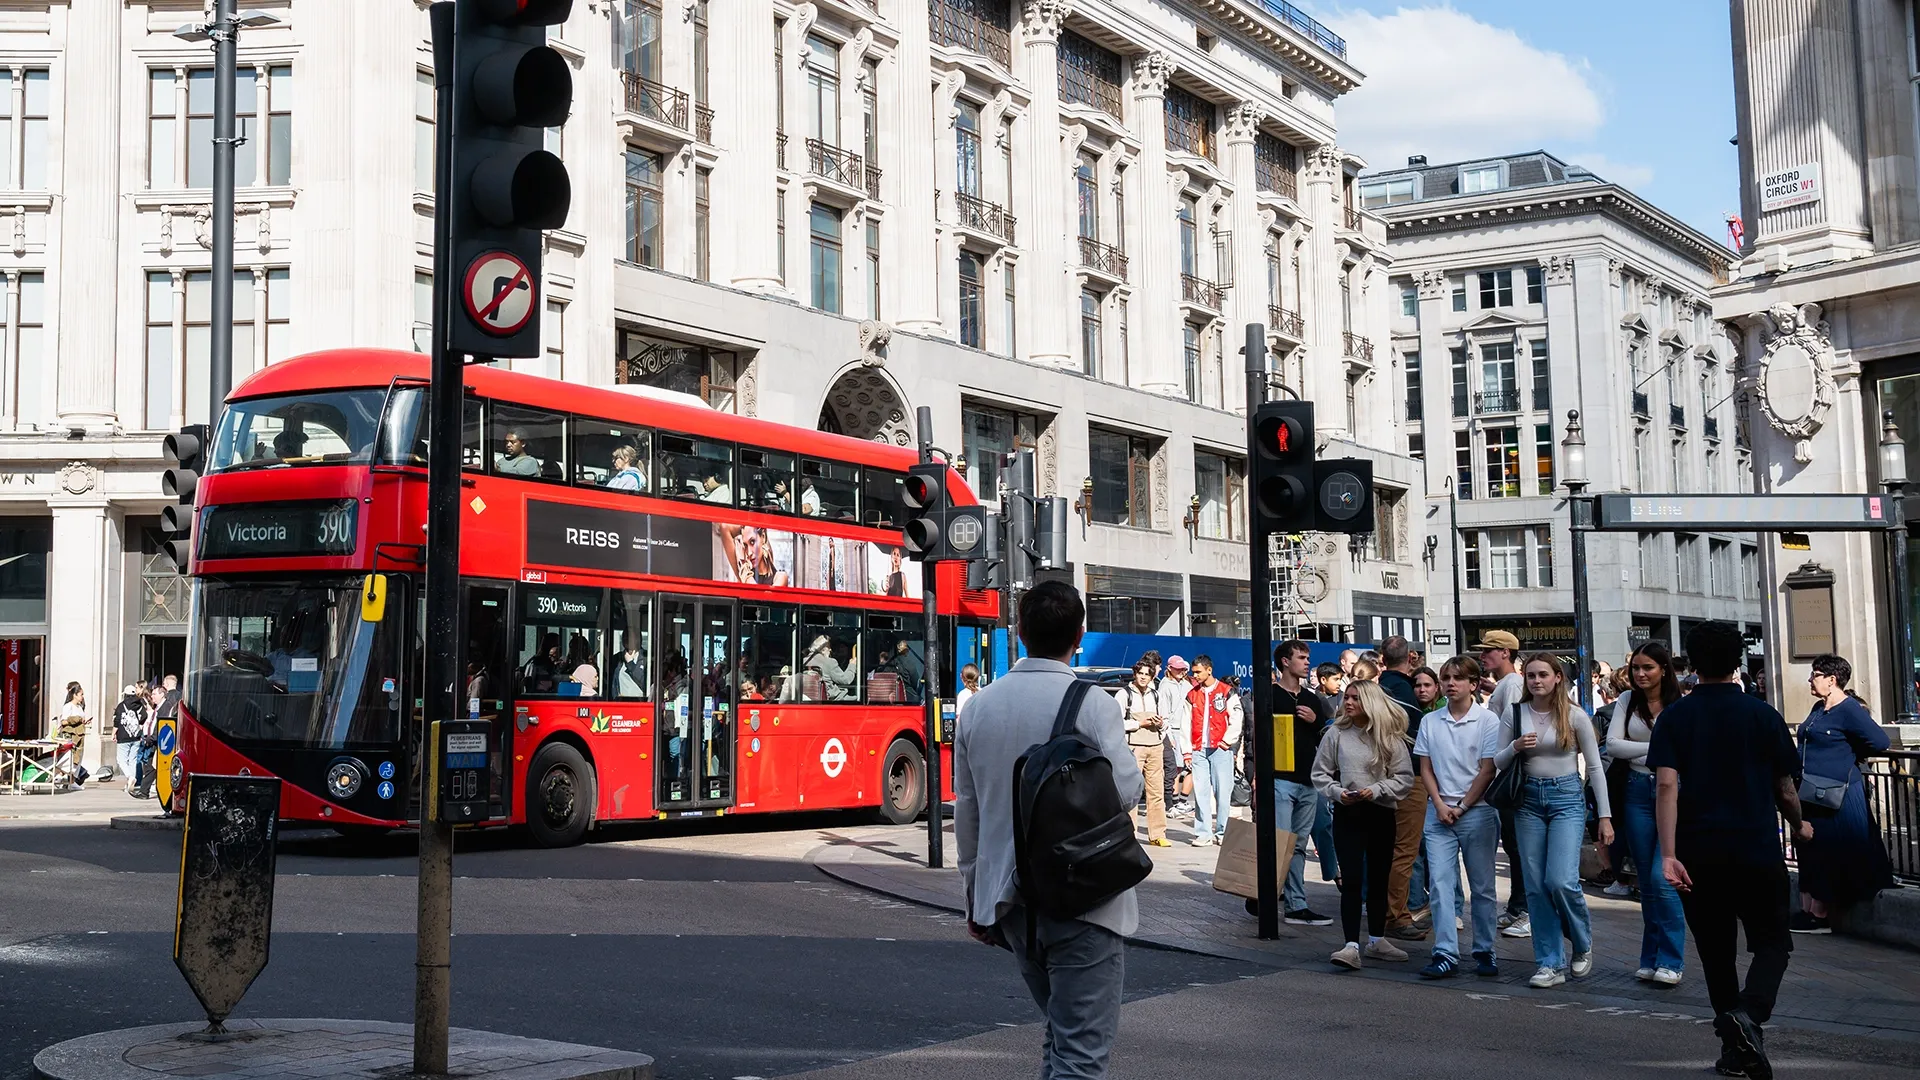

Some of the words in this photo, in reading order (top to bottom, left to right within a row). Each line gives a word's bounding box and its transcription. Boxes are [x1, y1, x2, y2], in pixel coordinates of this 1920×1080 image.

[1765, 171, 1800, 187] OXFORD
[1766, 183, 1798, 198] CIRCUS
[1800, 179, 1814, 190] W1
[1783, 194, 1811, 205] WESTMINSTER
[226, 522, 287, 542] Victoria
[317, 511, 349, 543] 390
[566, 527, 620, 549] REISS
[525, 571, 542, 582] global
[1381, 570, 1399, 590] VANS
[537, 596, 558, 614] 390
[562, 601, 587, 613] Victoria
[1517, 627, 1575, 641] OUTFITTER
[1232, 660, 1248, 678] Too
[449, 754, 481, 768] WAIT
